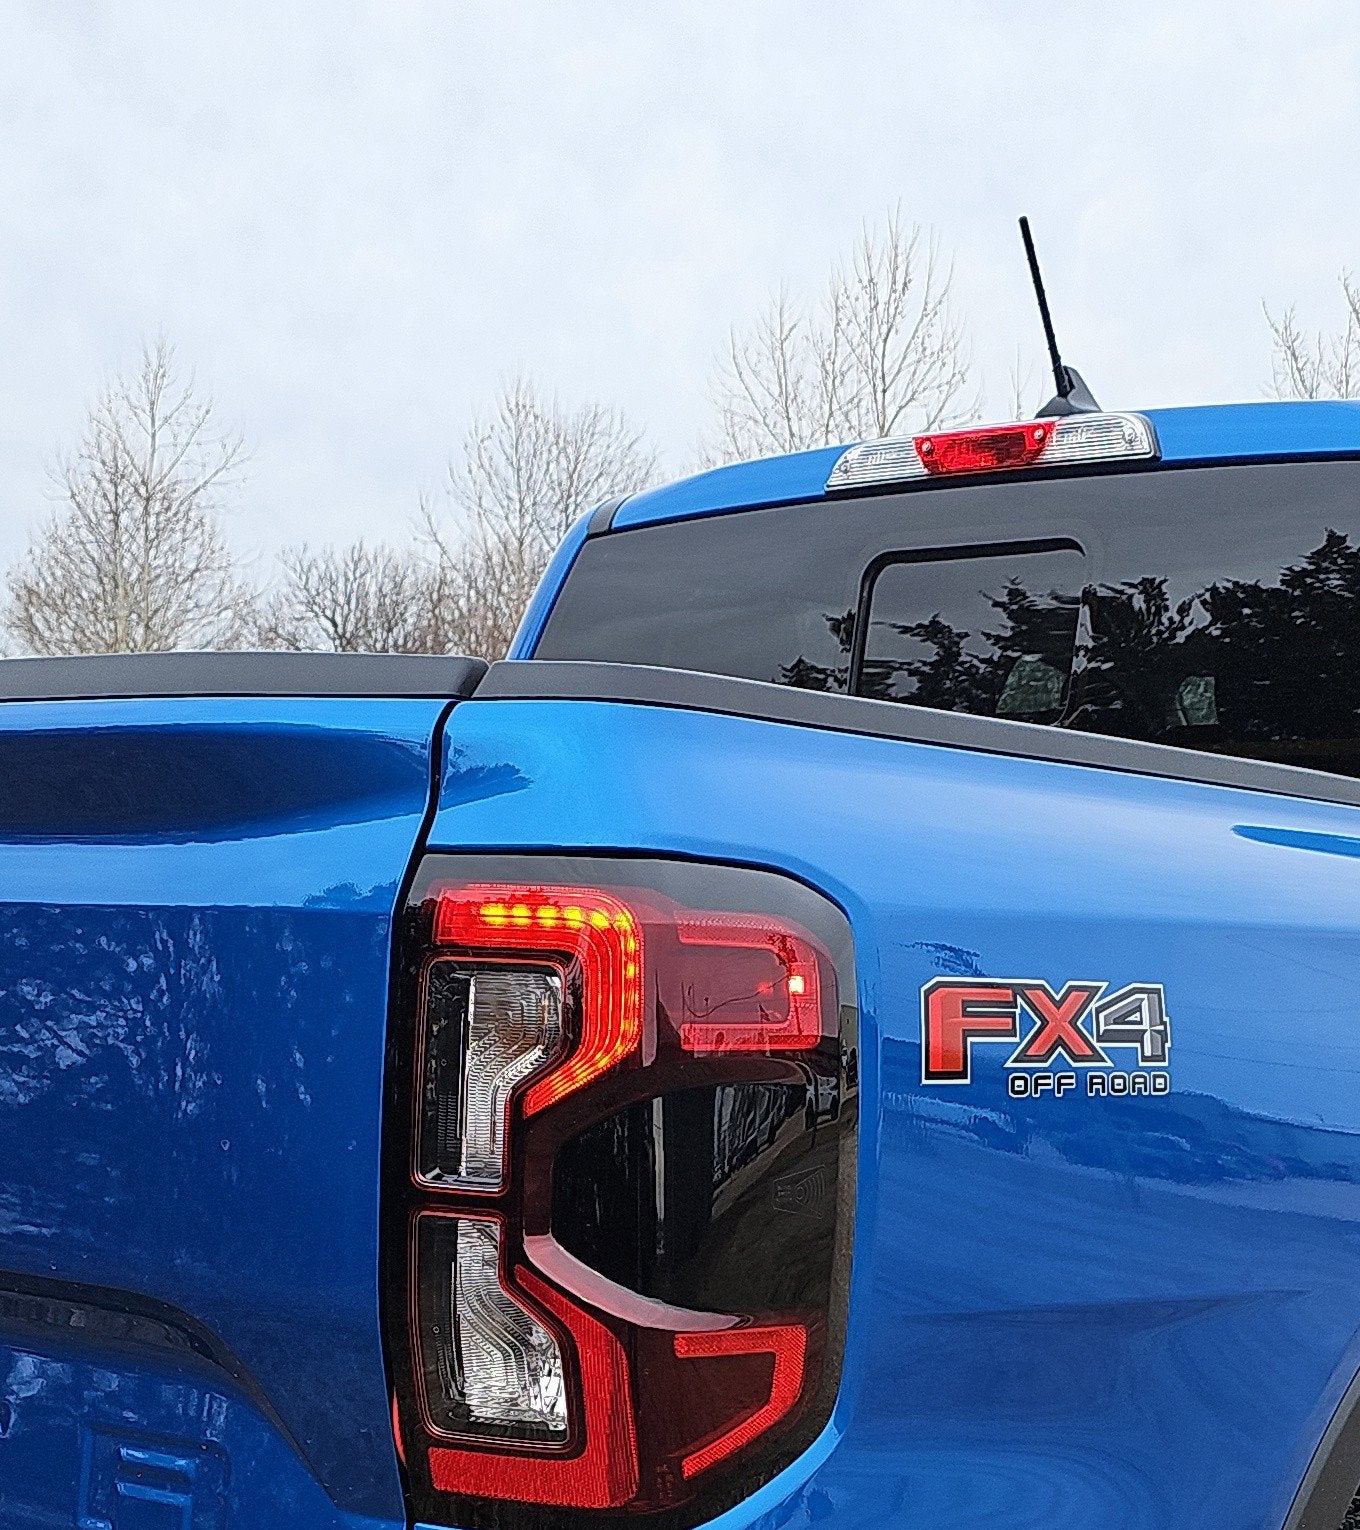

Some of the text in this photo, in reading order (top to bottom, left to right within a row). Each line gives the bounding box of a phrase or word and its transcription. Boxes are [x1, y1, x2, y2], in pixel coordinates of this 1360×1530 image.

[920, 976, 1171, 1085] FX4
[1008, 1071, 1170, 1098] OFF ROAD
